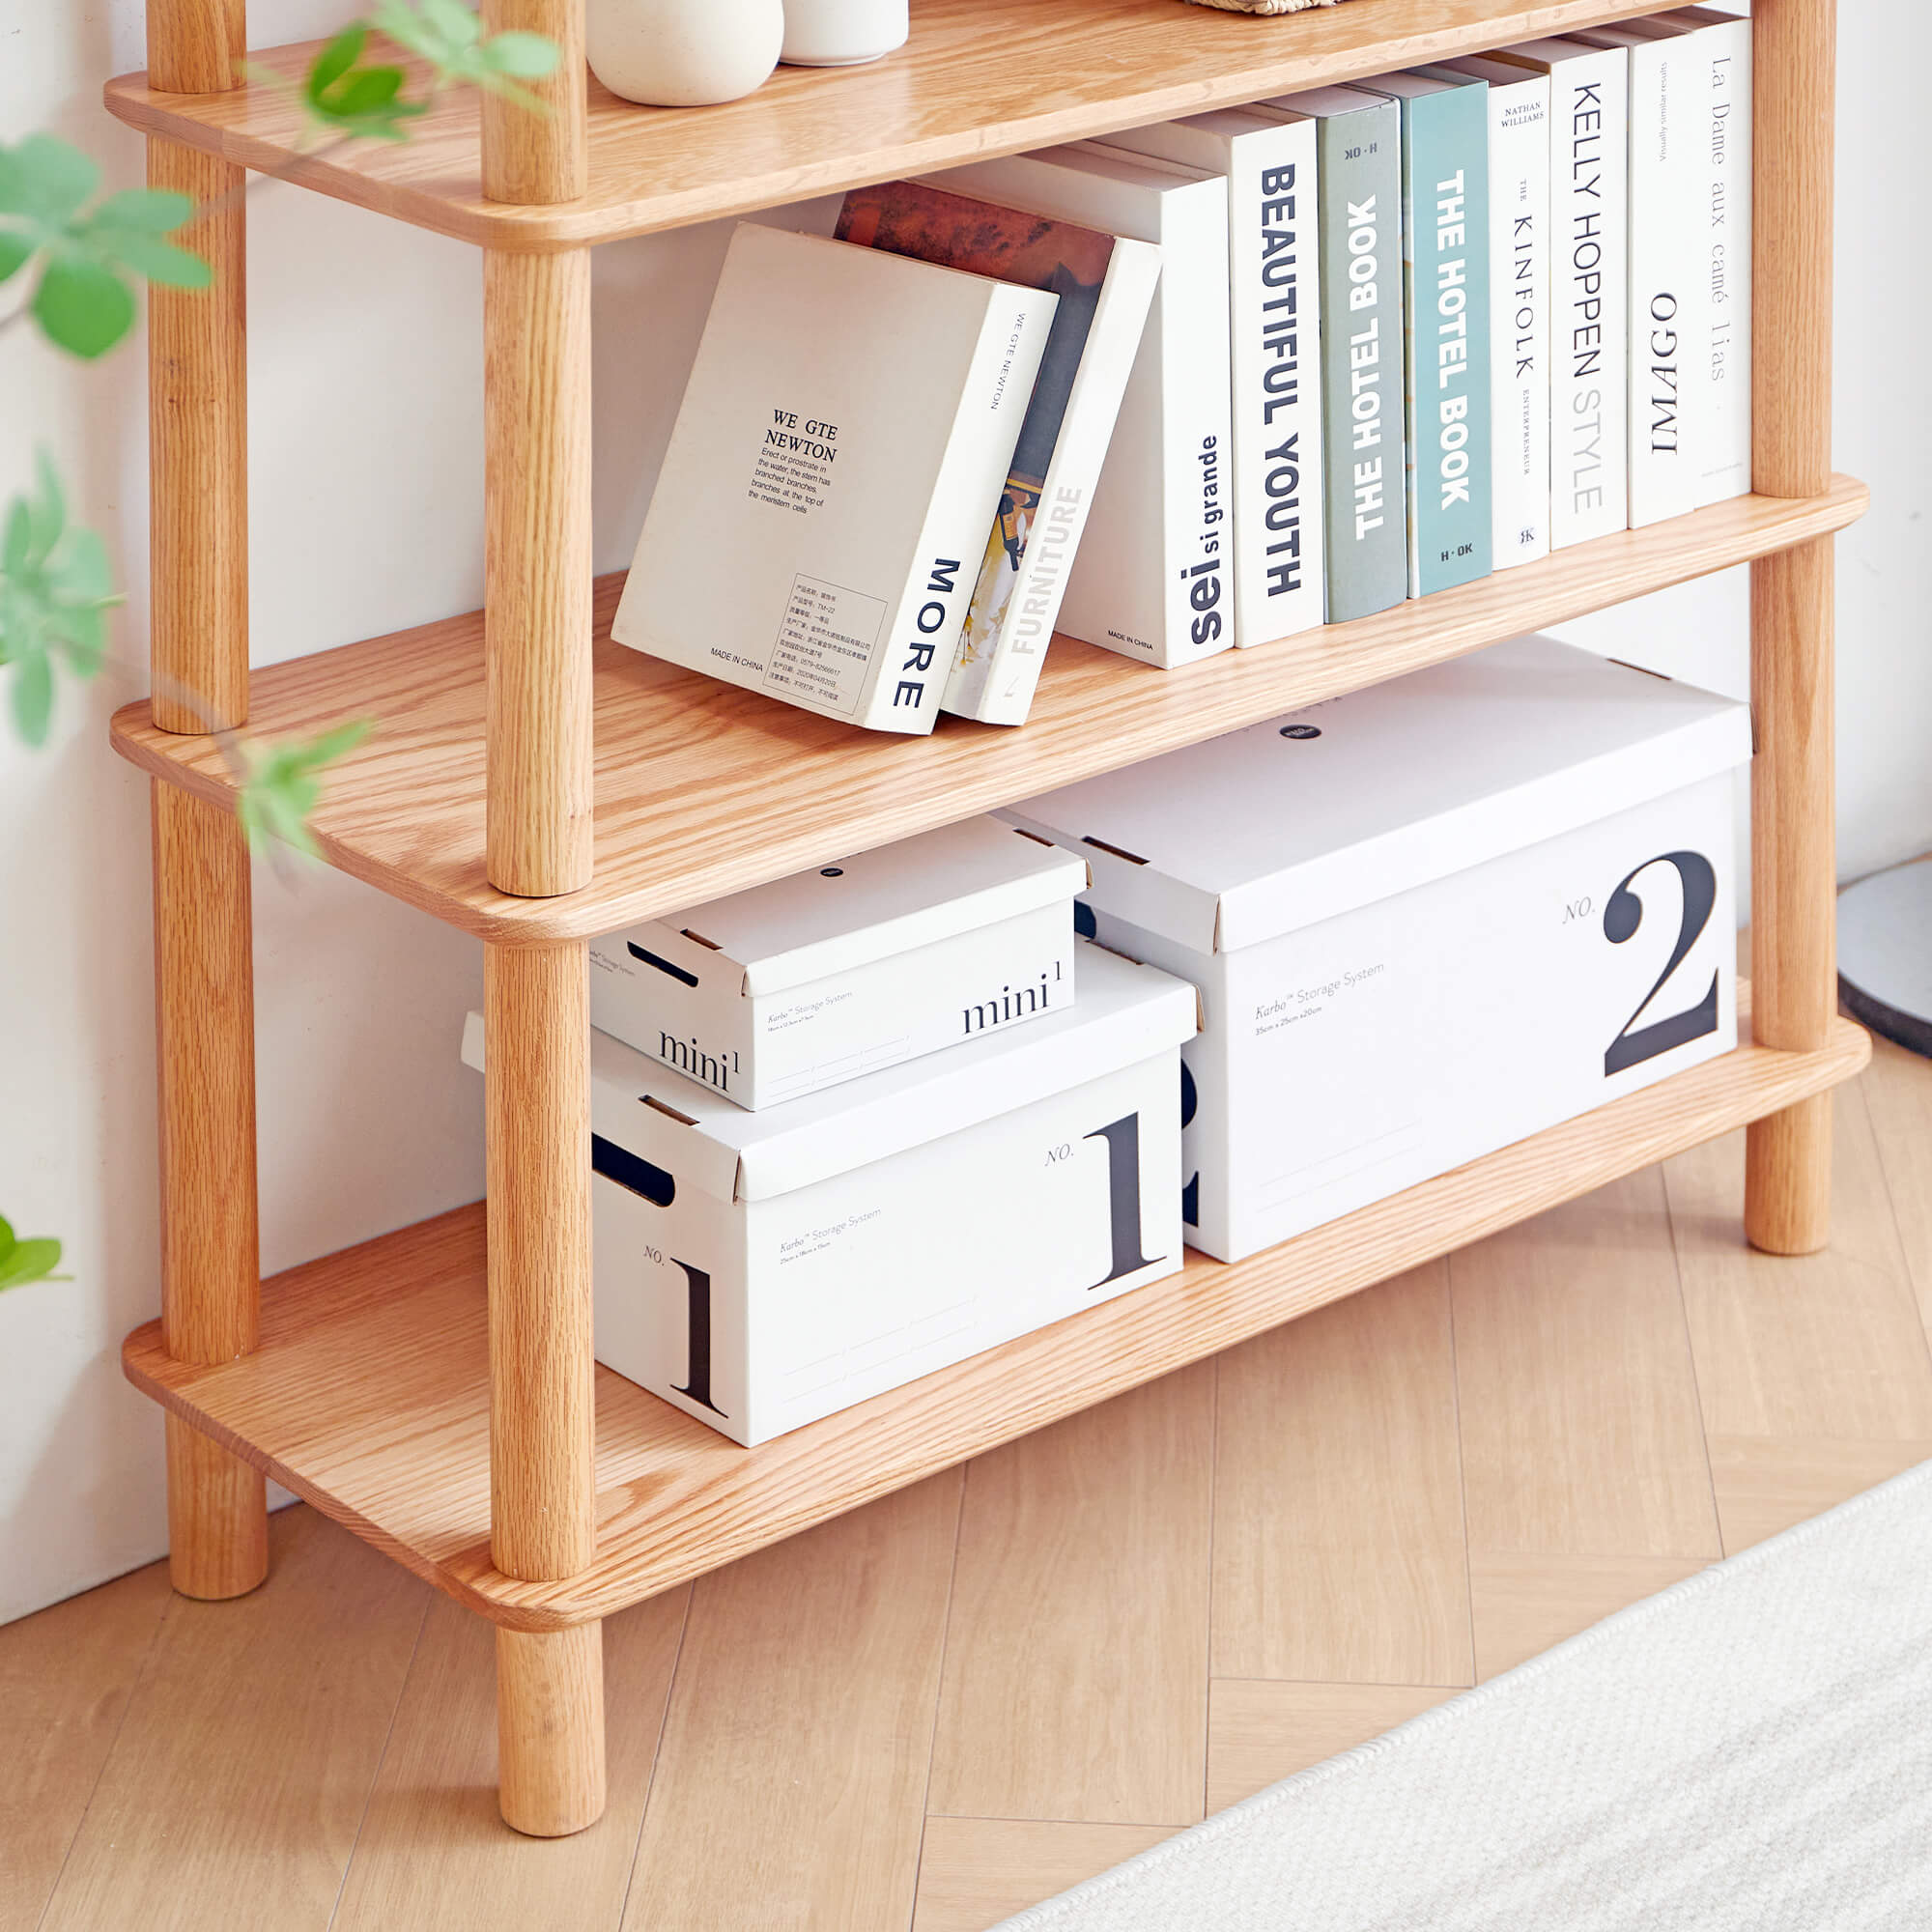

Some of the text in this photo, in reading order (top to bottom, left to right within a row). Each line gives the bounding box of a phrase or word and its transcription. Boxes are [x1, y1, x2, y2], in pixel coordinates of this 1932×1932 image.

[1712, 57, 1731, 89] La
[1501, 111, 1545, 128] WILLIAMS
[1505, 101, 1542, 117] NATHAN
[1659, 61, 1668, 161] Visually similar results
[1712, 102, 1731, 165] Dame
[1712, 182, 1725, 227] aux
[1515, 214, 1534, 379] KINFOLK
[1573, 82, 1603, 515] KELLY HOPPEN STYLE
[990, 313, 1026, 410] WE GTE NEWTON
[1436, 169, 1469, 511] THE HOTEL BOOK
[1262, 163, 1301, 597] BEAUTIFUL YOUTH
[1348, 194, 1383, 541] THE HOTEL BOOK
[1650, 292, 1678, 456] IMAGO
[765, 429, 838, 463] NEWTON
[774, 409, 838, 440] WE GTE
[754, 469, 785, 483] branched
[758, 458, 770, 468] the
[790, 468, 801, 477] the
[802, 471, 818, 482] stem
[819, 476, 831, 486] has
[761, 447, 780, 459] Erect
[788, 456, 819, 471] prostrate
[748, 489, 758, 499] the
[751, 478, 824, 507] branches at the top of
[1180, 435, 1223, 645] sei si grande
[1010, 486, 1082, 655] FURNITURE
[710, 647, 763, 672] MADE IN CHINA
[893, 557, 961, 708] MORE
[1108, 630, 1126, 641] MADE
[1134, 639, 1153, 650] CHINA
[1297, 980, 1341, 1004] Storage
[1344, 964, 1383, 987] System
[1562, 849, 1719, 1078] NO. 2
[812, 1222, 846, 1240] Storage
[848, 1209, 881, 1228] System
[1043, 1143, 1074, 1167] NO.
[1082, 1111, 1168, 1291] 1
[643, 1245, 729, 1419] NO. 1
